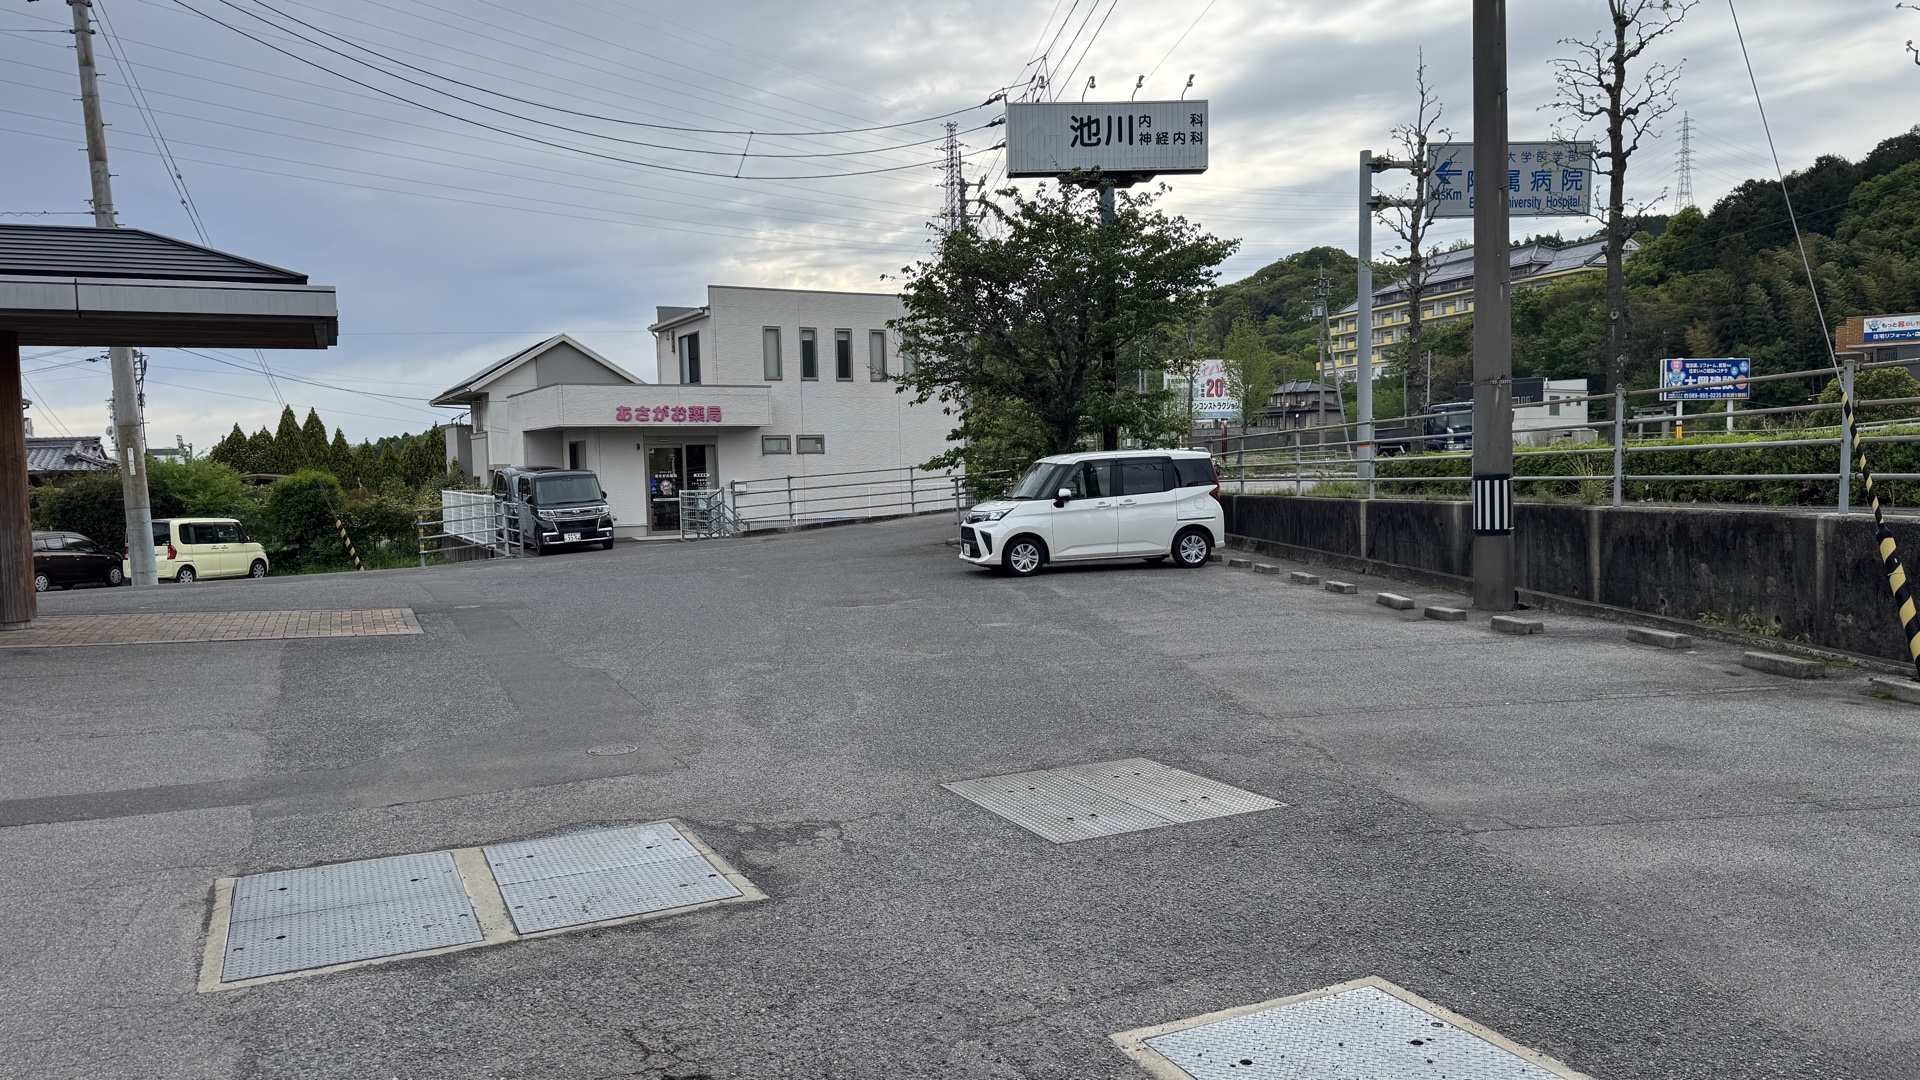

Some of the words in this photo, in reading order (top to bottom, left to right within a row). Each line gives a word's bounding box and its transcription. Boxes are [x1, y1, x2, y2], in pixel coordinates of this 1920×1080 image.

[1070, 115, 1133, 147] 池川
[1139, 131, 1203, 146] 神経内科
[1546, 196, 1580, 209] Hospital
[1206, 378, 1223, 397] 20
[616, 405, 722, 422] あさがお薬局
